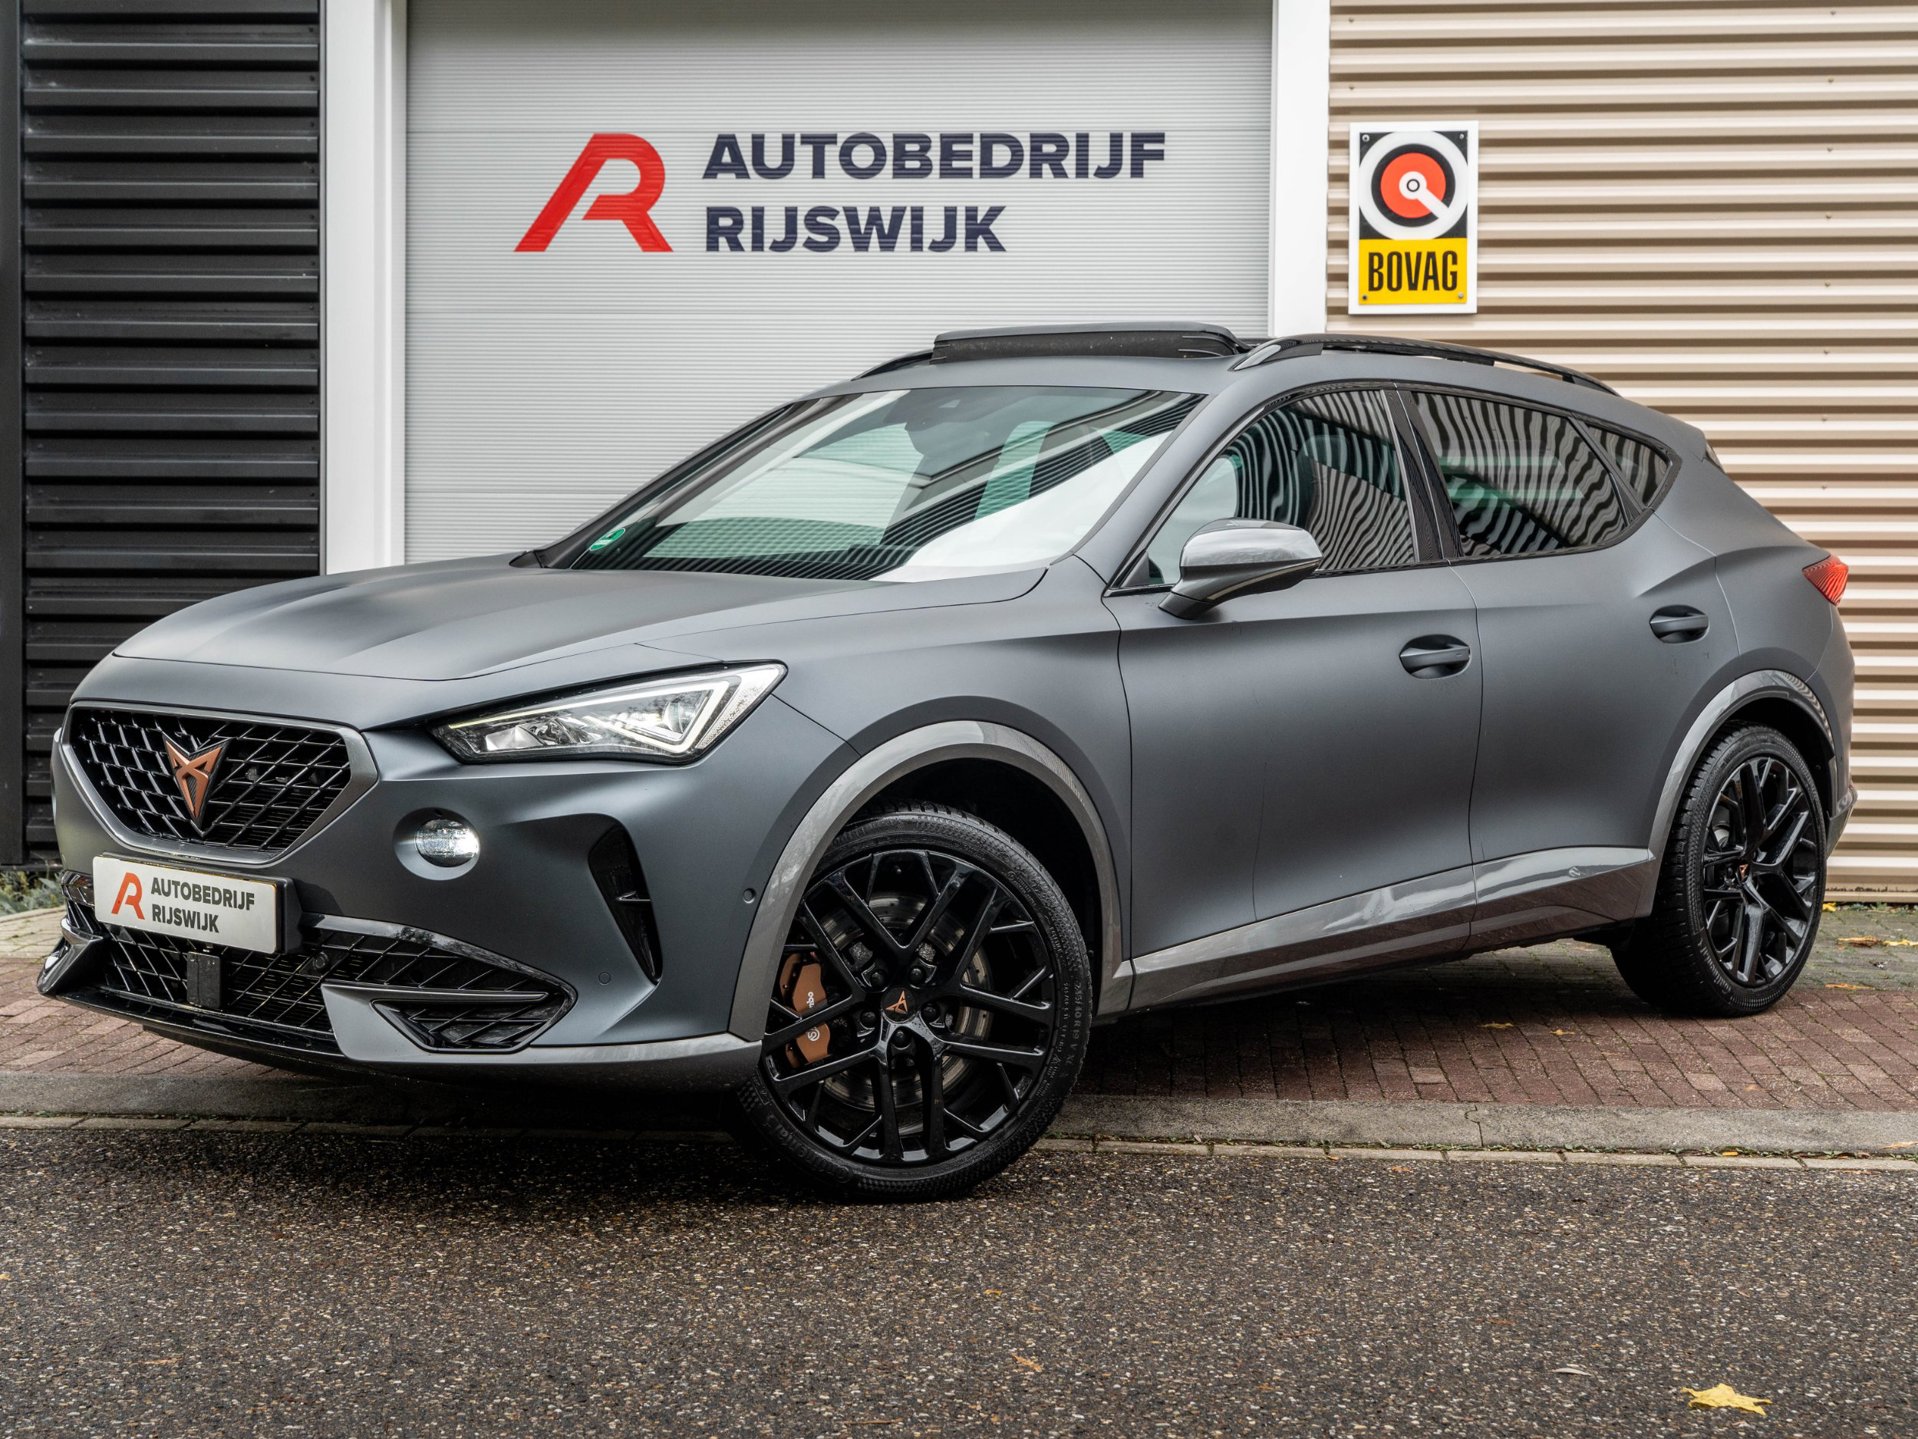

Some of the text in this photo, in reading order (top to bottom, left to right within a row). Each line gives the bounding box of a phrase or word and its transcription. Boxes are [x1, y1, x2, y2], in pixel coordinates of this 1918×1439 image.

[702, 132, 1166, 179] AUTOBEDRIJF
[705, 206, 1007, 252] RIJSWIJK
[1368, 251, 1458, 292] BOVAG
[151, 877, 255, 911] AUTOBEDRIJF
[152, 904, 219, 933] RIJSWIJK
